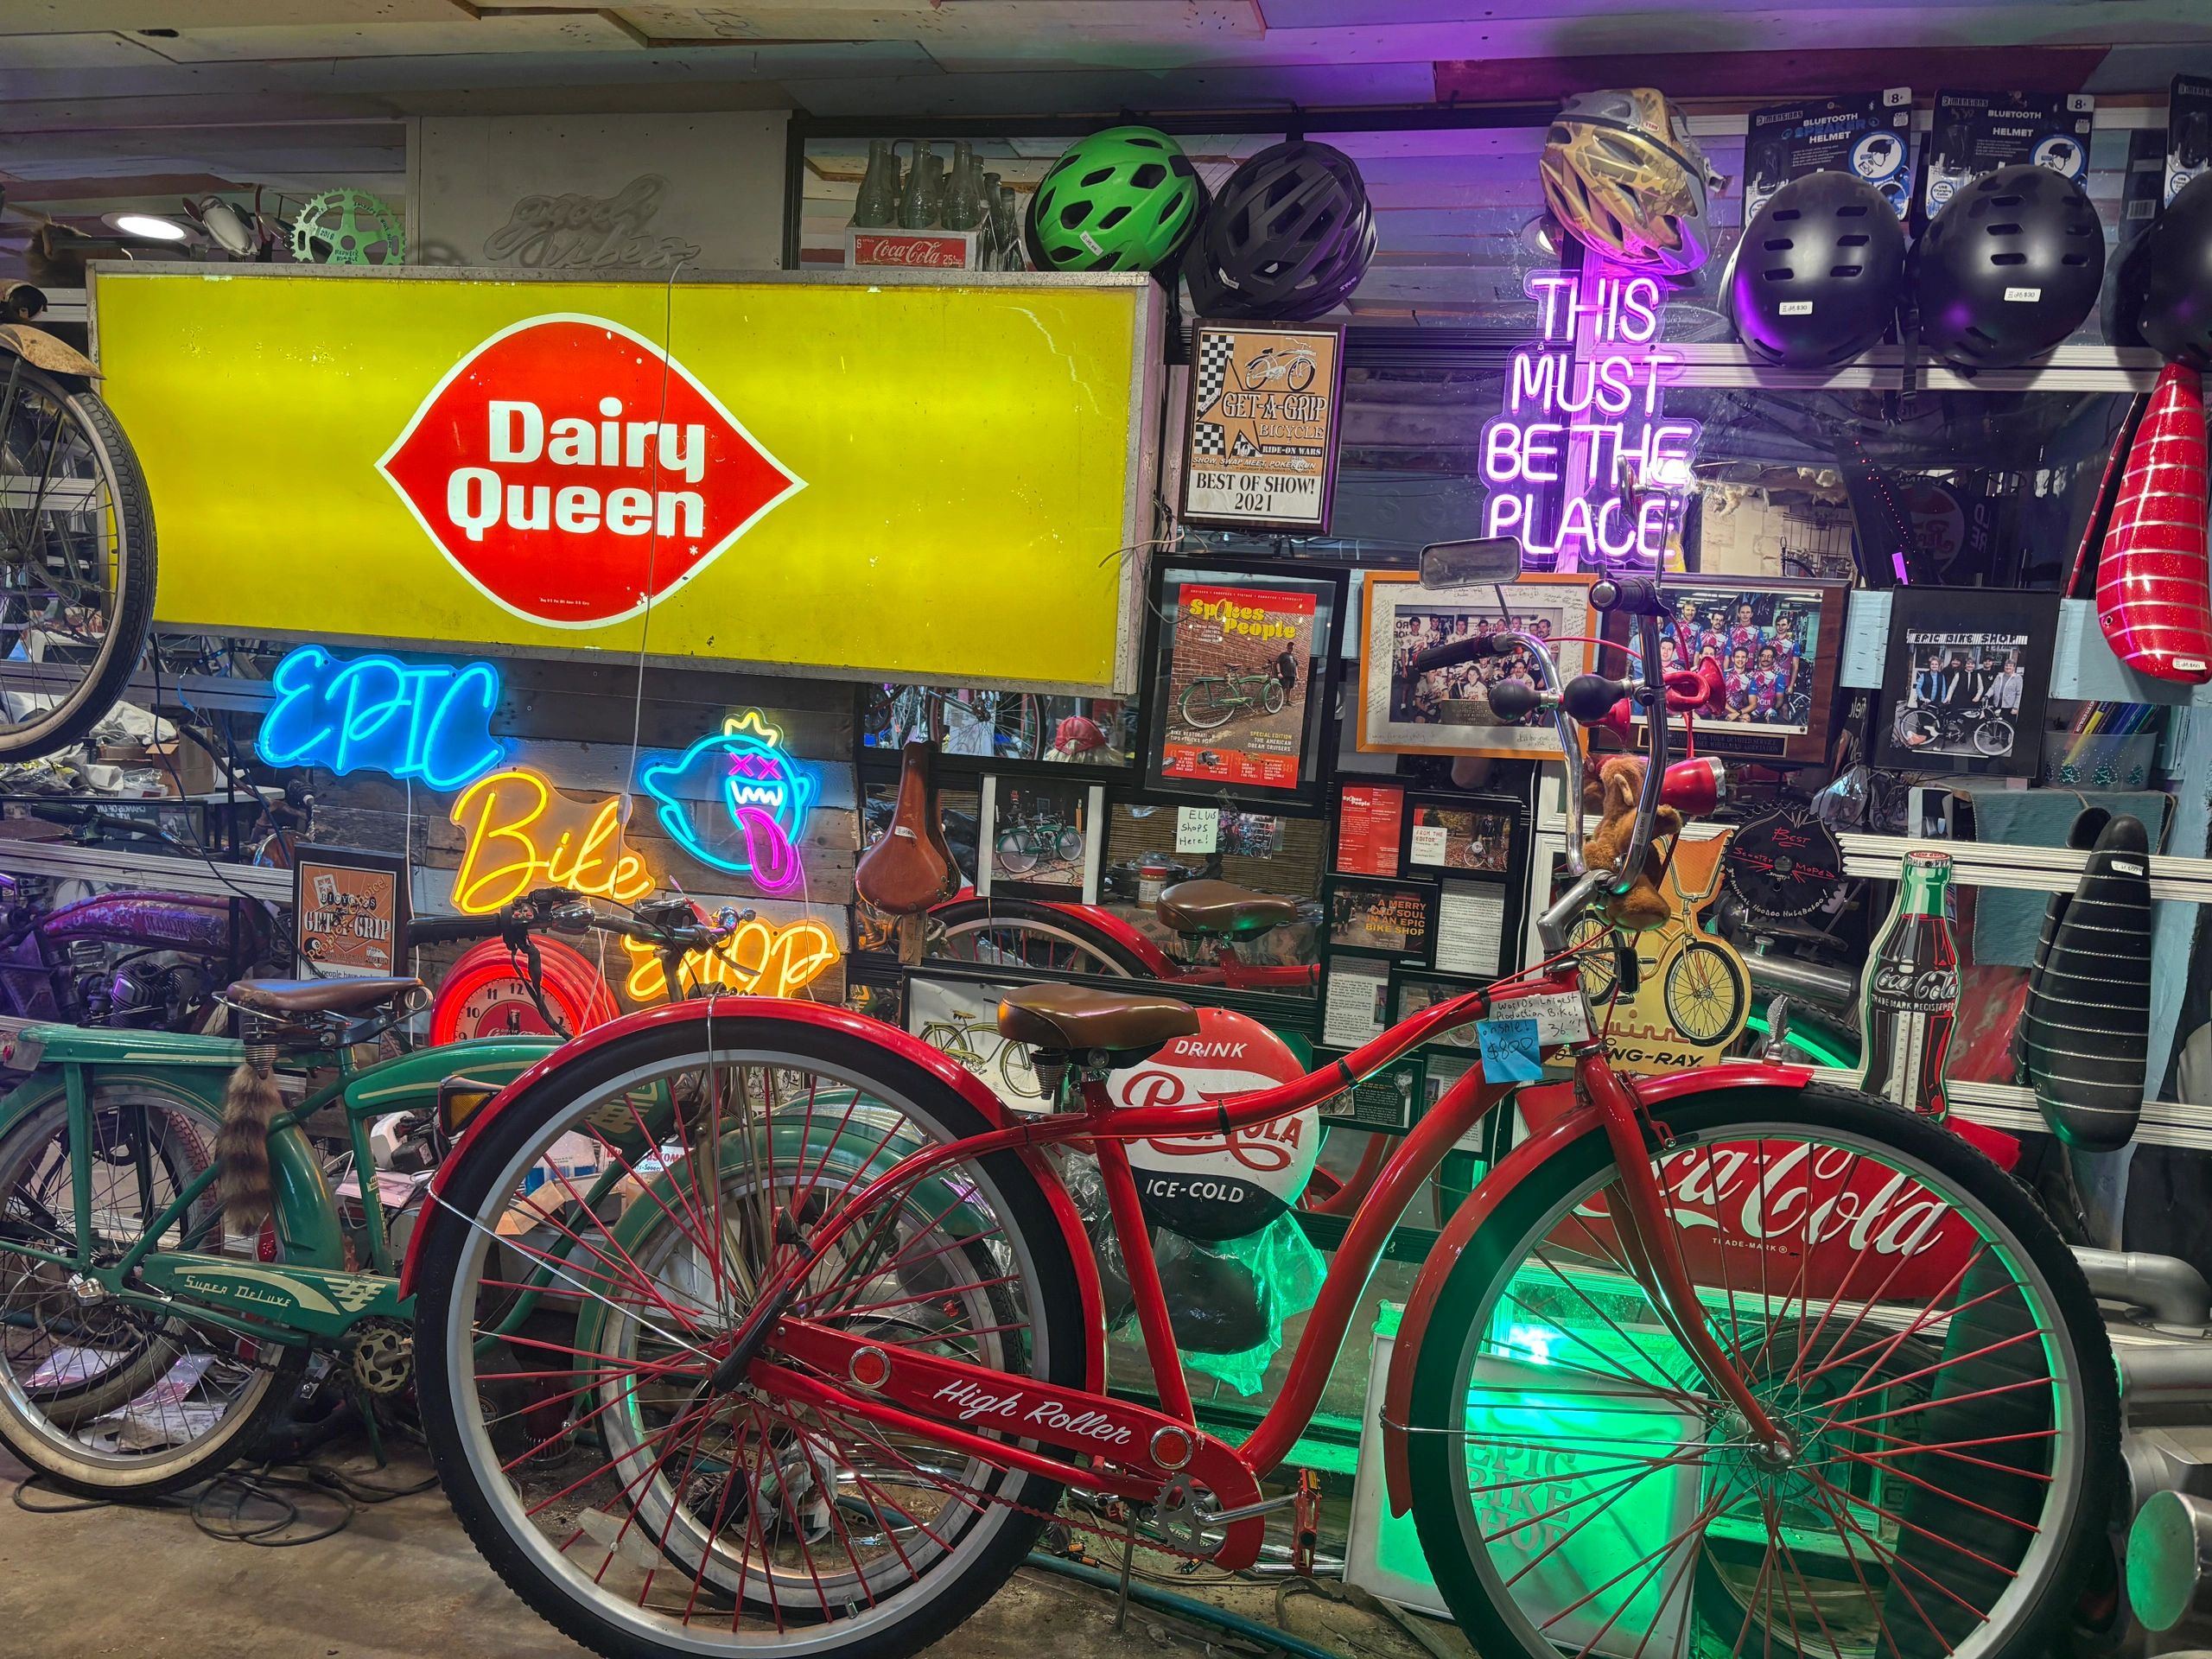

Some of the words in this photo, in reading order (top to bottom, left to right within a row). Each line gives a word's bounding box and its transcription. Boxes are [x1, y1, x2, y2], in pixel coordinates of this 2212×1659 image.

[1803, 113, 1859, 127] BLUETOOTH
[1988, 110, 2041, 119] BLUETOOTH
[1795, 119, 1866, 137] SPEAKER
[1809, 130, 1851, 144] HELMET
[1993, 127, 2033, 137] HELMET
[873, 239, 944, 264] Coca-Cola
[1531, 276, 1659, 344] THIS
[1511, 353, 1678, 416] MUST
[1222, 391, 1327, 423] GET-A-GRIP
[488, 396, 706, 483] Dairy
[1262, 445, 1296, 455] RIDE-ON
[1299, 447, 1321, 456] WARS
[1486, 423, 1562, 482] BE
[1572, 423, 1694, 490] THE
[1220, 458, 1243, 467] SWAP
[1197, 473, 1236, 491] BEST
[1240, 474, 1261, 492] OF
[1264, 476, 1316, 494] SHOW!
[447, 467, 704, 542] Queen
[1235, 493, 1272, 512] 2021
[1489, 493, 1681, 557] PLACE
[1189, 597, 1265, 621] Spokes
[1224, 617, 1296, 642] People
[1914, 633, 1942, 643] EPIC
[1945, 634, 1974, 643] BIKE
[1980, 634, 2018, 645] SHOP
[264, 650, 499, 786] EPIC
[454, 771, 650, 913] Bike
[1179, 834, 1209, 846] Here!
[1389, 899, 1427, 911] MERRY
[1396, 909, 1426, 919] SOUL
[1365, 923, 1391, 933] BIKE
[1395, 926, 1425, 936] SHOP
[1400, 918, 1426, 928] EPIC
[322, 969, 342, 978] people
[510, 982, 524, 995] 12
[1873, 966, 1959, 1001] Coca-Cola
[486, 988, 498, 1001] 11
[466, 1007, 480, 1019] 10
[1890, 999, 1911, 1010] MARK
[1173, 1039, 1248, 1058] DRINK
[1487, 1036, 1534, 1063] $800
[1145, 1179, 1244, 1204] ICE-COLD
[933, 1380, 1020, 1421] High
[1024, 1401, 1133, 1446] Roller
